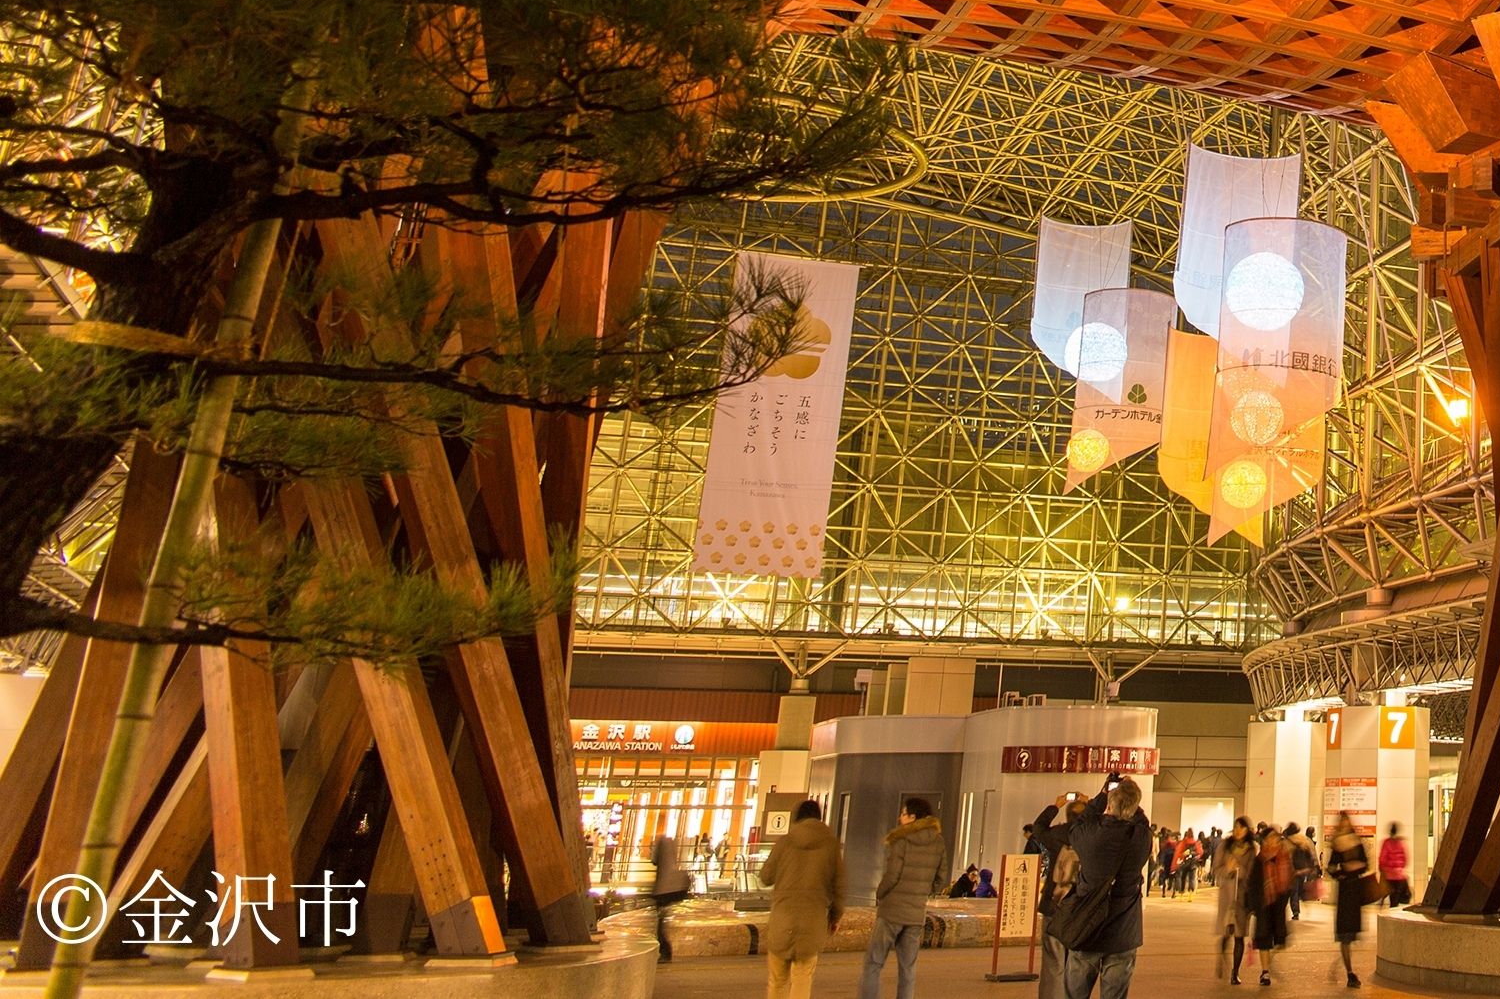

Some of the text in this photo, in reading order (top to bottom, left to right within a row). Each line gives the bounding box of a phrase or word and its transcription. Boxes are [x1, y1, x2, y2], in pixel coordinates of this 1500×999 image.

[743, 392, 763, 454] かなざわ
[769, 394, 788, 456] ごちそう
[794, 395, 811, 439] 五感に
[581, 723, 652, 740] 金沢駅
[1387, 712, 1408, 743] 7
[573, 742, 662, 751] ANAZAWA STATION
